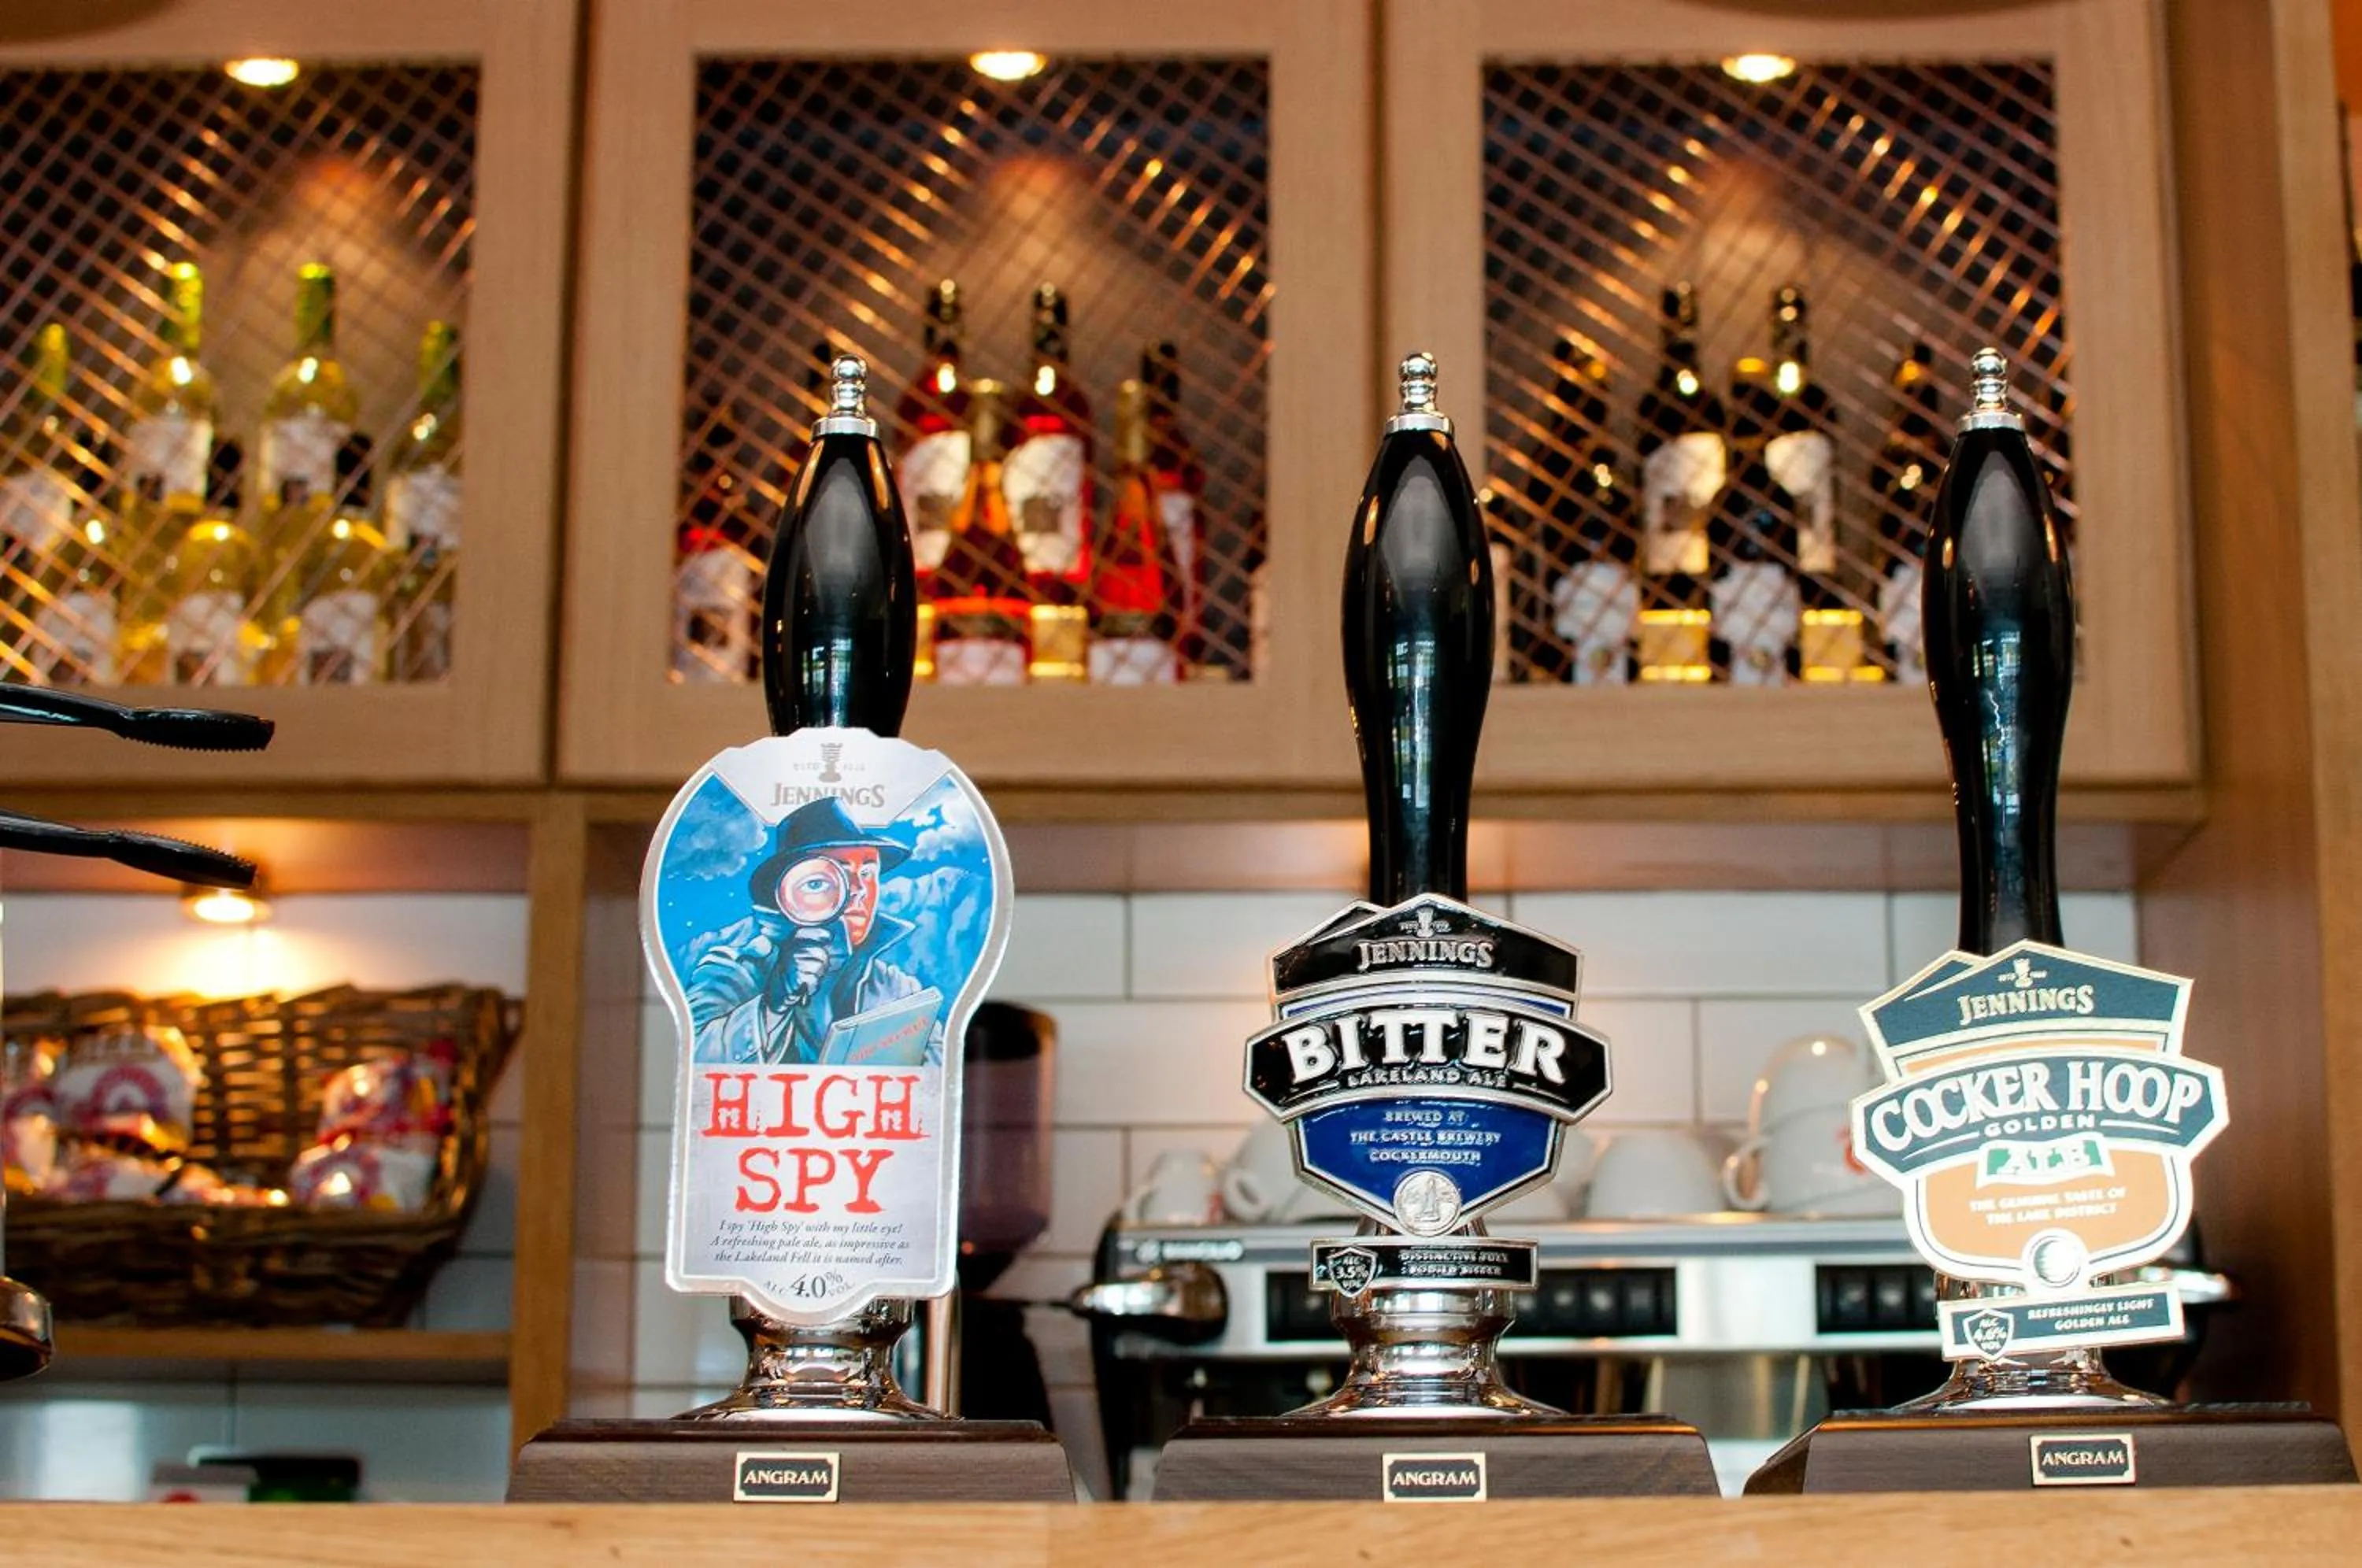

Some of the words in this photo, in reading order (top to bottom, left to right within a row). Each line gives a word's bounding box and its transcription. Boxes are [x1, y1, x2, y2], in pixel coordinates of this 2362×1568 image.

[770, 782, 885, 808] JENNINGS
[1356, 939, 1494, 971] JENNINGS
[1956, 984, 2094, 1026] JENNINGS
[1281, 1008, 1568, 1085] BITTER
[1347, 1067, 1460, 1088] LAKELAND
[1468, 1071, 1507, 1089] ALE
[698, 1073, 931, 1141] HIGH
[1871, 1062, 2059, 1152] COCKER
[2067, 1060, 2203, 1123] HOOP
[1383, 1111, 1442, 1122] BREWED
[1984, 1114, 2095, 1137] GOLDEN
[1350, 1131, 1376, 1143] THE
[1380, 1130, 1432, 1142] CASTLE
[1437, 1131, 1501, 1144] BREWERY
[1369, 1148, 1481, 1162] COCKERMOUTH
[735, 1147, 894, 1214] SPY
[720, 1220, 727, 1230] I
[727, 1222, 744, 1233] spy
[805, 1222, 830, 1233] with
[832, 1225, 850, 1234] my
[851, 1222, 878, 1233] little
[710, 1237, 721, 1247] A
[721, 1236, 776, 1248] refreshing
[777, 1237, 800, 1249] pale
[839, 1240, 894, 1252] impressive
[714, 1252, 733, 1262] the
[734, 1252, 788, 1263] Lakeland
[790, 1252, 811, 1263] Fell
[813, 1255, 821, 1263] it
[824, 1255, 833, 1263] is
[835, 1253, 873, 1264] named
[1336, 1264, 1369, 1279] 3.5%
[2054, 1317, 2105, 1331] GOLDEN
[2108, 1314, 2130, 1326] ALE
[2042, 1450, 2125, 1466] ANGRAM
[743, 1470, 828, 1485] ANGRAM
[1392, 1470, 1476, 1485] ANGRAM
